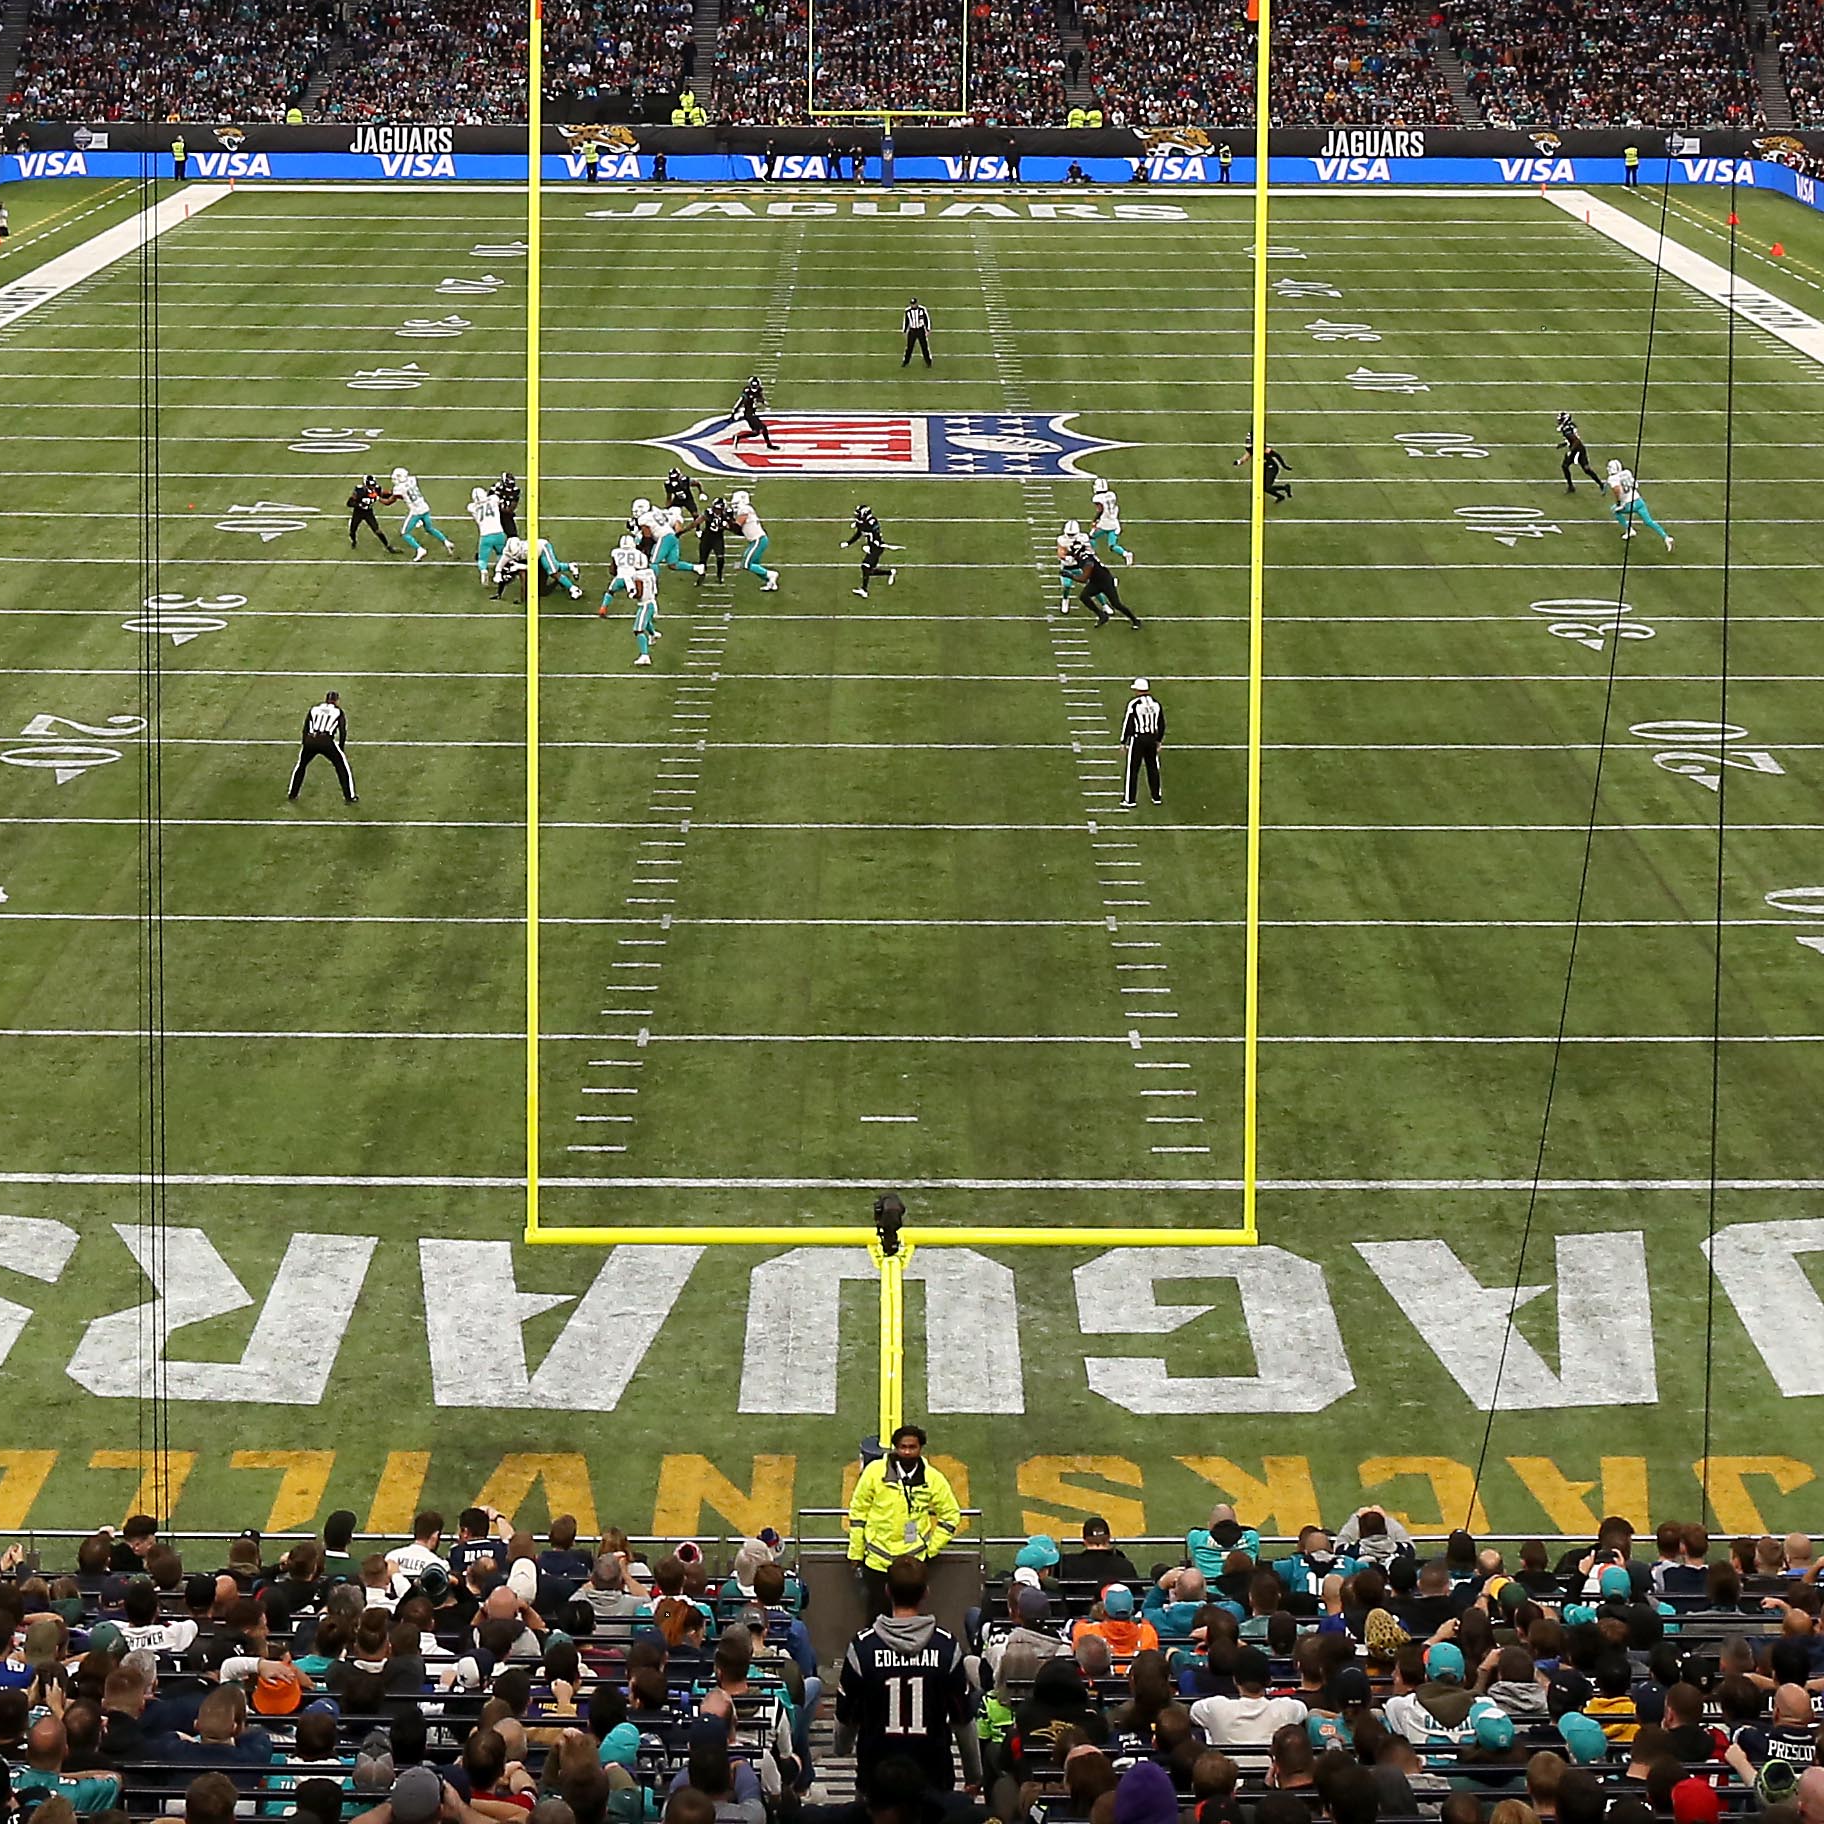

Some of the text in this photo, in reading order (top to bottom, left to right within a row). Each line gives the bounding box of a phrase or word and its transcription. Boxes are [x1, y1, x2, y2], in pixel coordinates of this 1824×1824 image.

[349, 125, 453, 154] JAGUARS
[1321, 129, 1424, 158] JAGUARS
[13, 152, 87, 177] VISA
[187, 152, 271, 177] VISA
[375, 153, 457, 177] VISA
[558, 154, 641, 179] VSA
[1123, 156, 1207, 181] VISA
[1308, 157, 1393, 182] VISA
[1492, 158, 1577, 183] VISA
[1679, 159, 1755, 184] VISA
[1794, 173, 1815, 206] VISA
[585, 201, 1189, 221] JAGUARS
[1716, 293, 1816, 330] LONDON
[1394, 431, 1490, 459] 50
[213, 500, 321, 535] 40
[478, 504, 495, 523] 74
[1454, 504, 1564, 537] 40
[121, 592, 248, 636] 30
[1530, 598, 1656, 643] 30
[1628, 719, 1785, 776] 20
[396, 1555, 428, 1573] MILLER
[884, 1676, 930, 1735] 11
